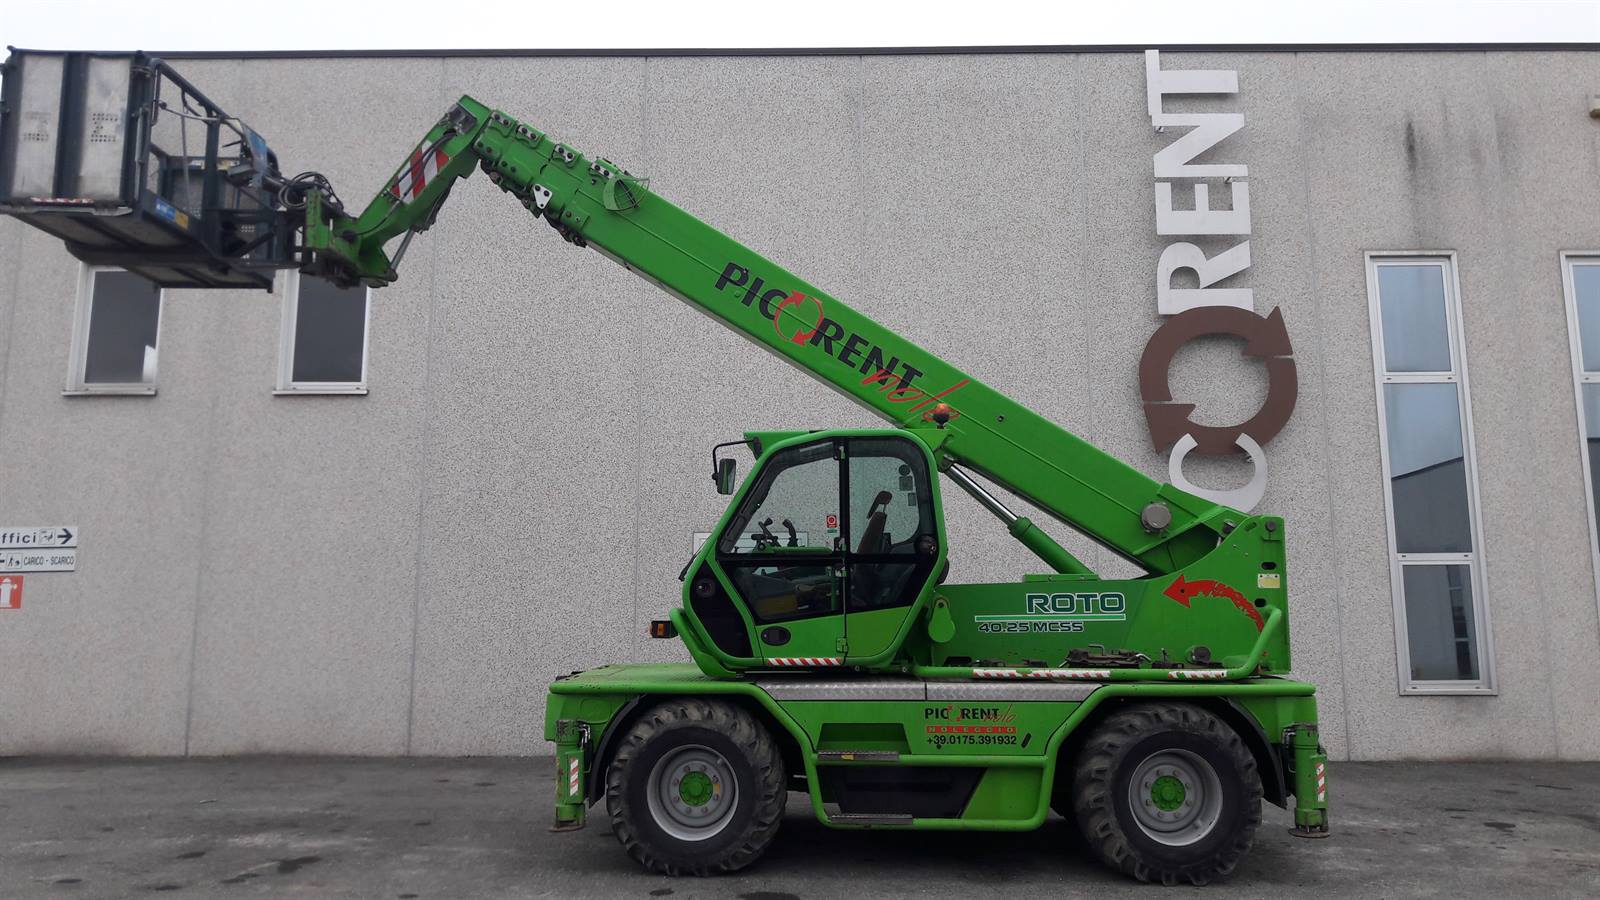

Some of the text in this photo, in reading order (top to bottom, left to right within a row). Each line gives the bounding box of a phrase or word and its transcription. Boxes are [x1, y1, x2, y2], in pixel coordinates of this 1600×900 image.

[1, 532, 37, 543] ffici
[23, 556, 44, 566] CARICO
[50, 556, 75, 566] SCARICO
[1026, 592, 1126, 614] ROTO
[978, 621, 1085, 633] 40.25 MCSS
[927, 735, 1017, 745] +39.0175.391932
